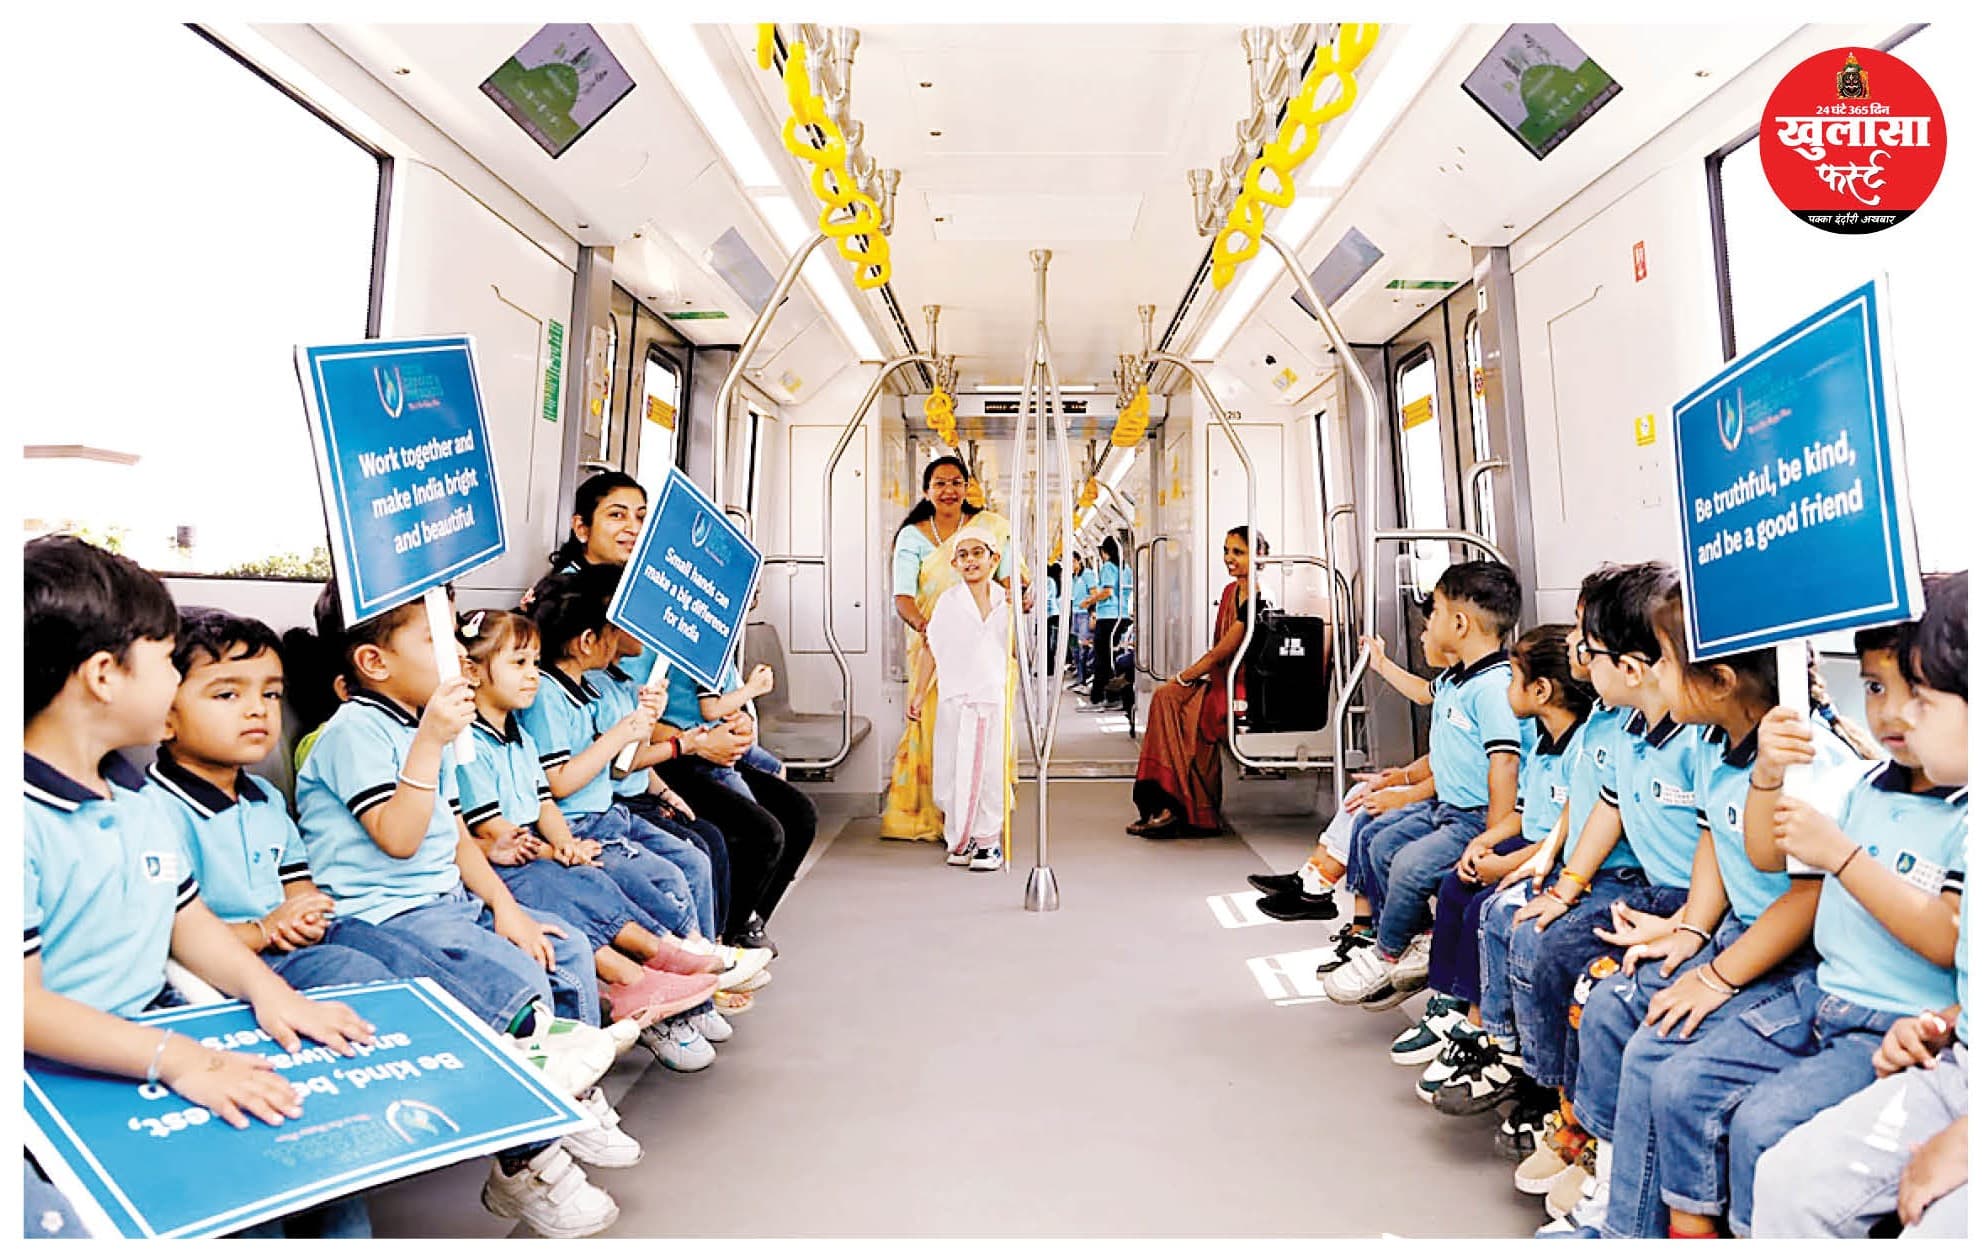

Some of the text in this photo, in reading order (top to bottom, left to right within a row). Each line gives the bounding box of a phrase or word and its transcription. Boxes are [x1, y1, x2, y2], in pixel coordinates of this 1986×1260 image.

[358, 429, 474, 479] Work together and
[1695, 430, 1856, 524] Be truthful, be kind,
[372, 467, 479, 519] make India bright
[393, 503, 476, 554] and beautiful
[1697, 478, 1864, 566] and be a good friend
[644, 564, 731, 638] make a big difference
[664, 547, 730, 609] Small hands can
[663, 605, 700, 644] for India
[333, 1060, 420, 1089] kind,
[417, 1052, 464, 1071] Be
